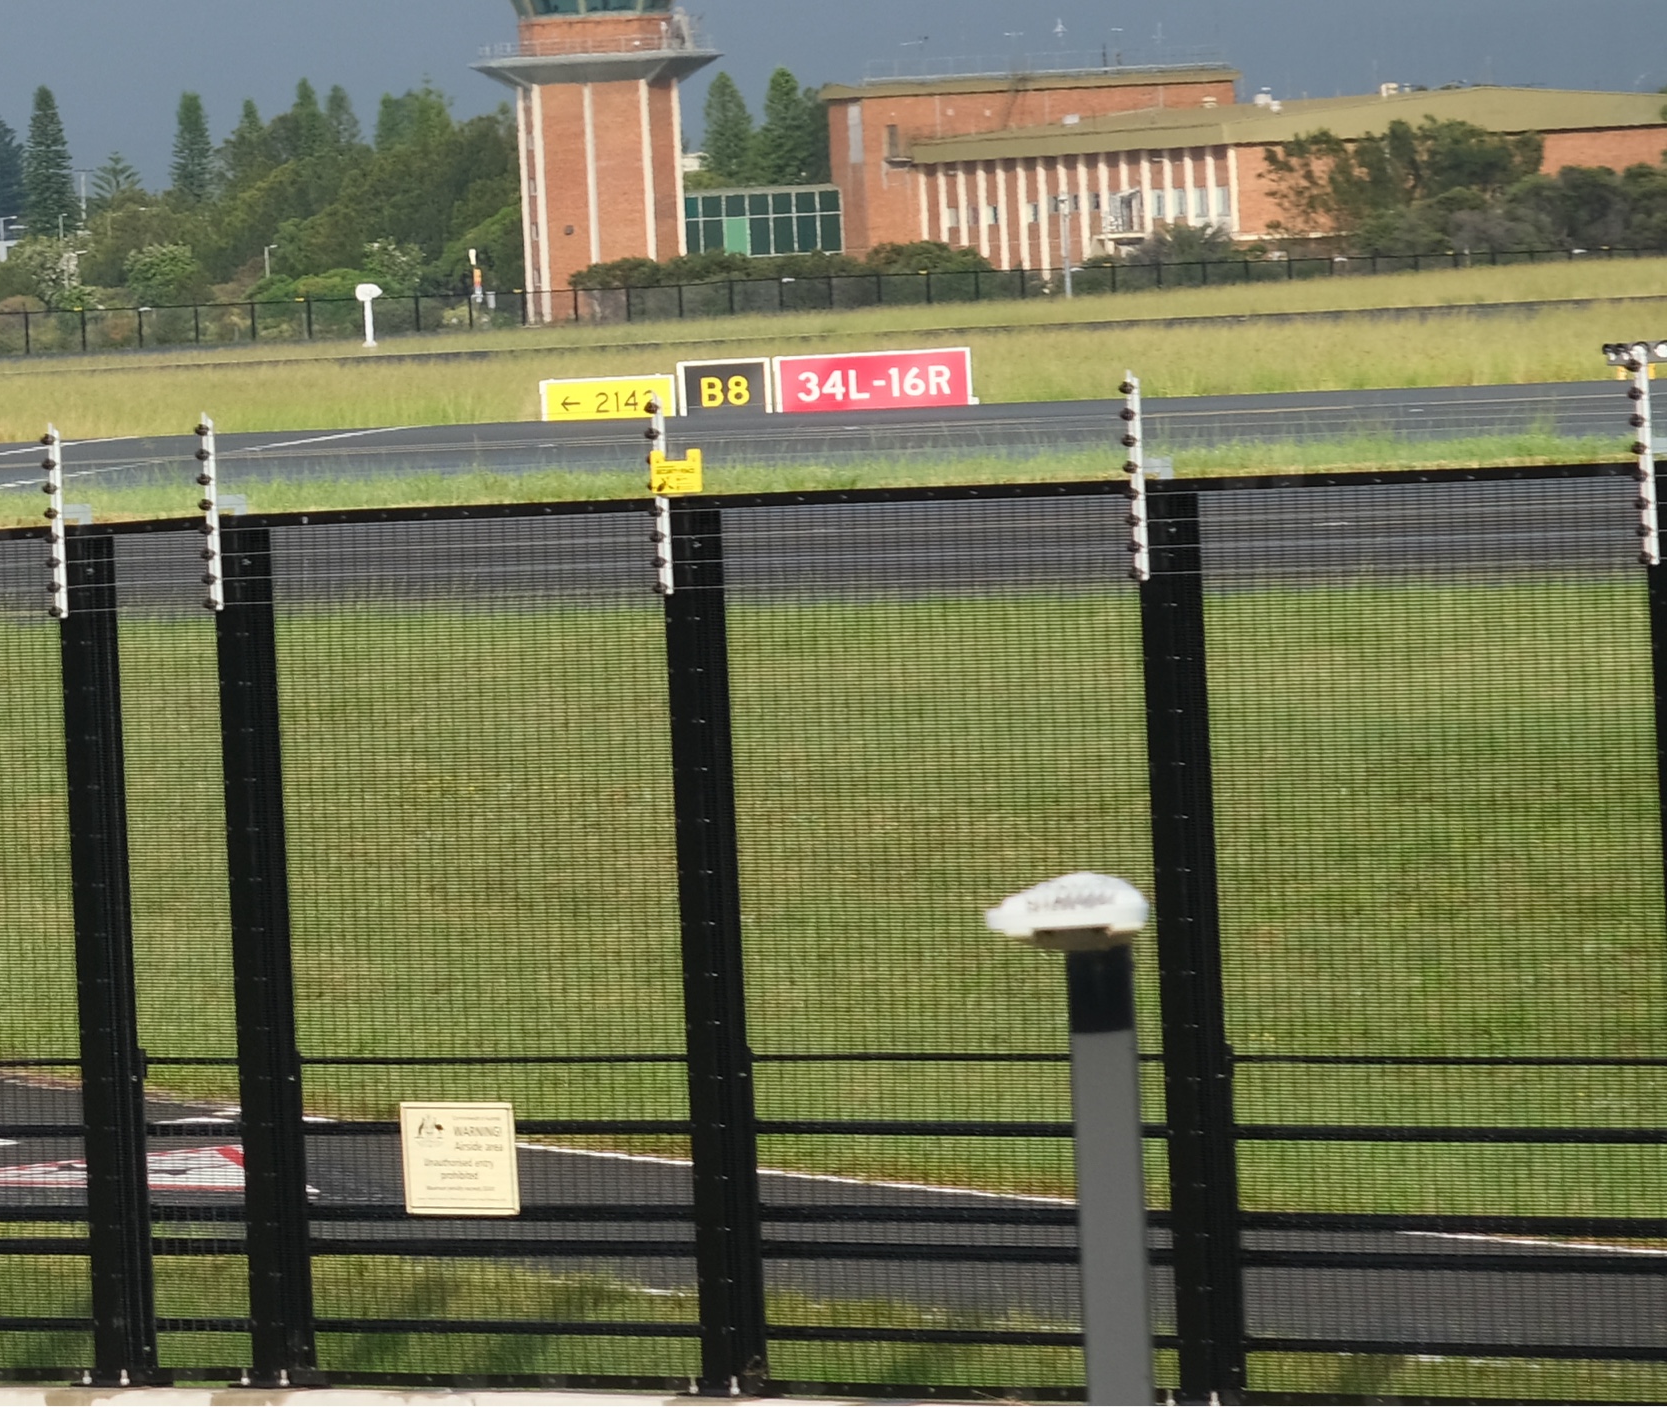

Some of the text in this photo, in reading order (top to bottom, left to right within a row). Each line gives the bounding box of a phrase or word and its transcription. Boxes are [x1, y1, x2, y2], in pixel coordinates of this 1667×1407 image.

[797, 365, 952, 403] 34L-16R
[699, 375, 751, 407] B8
[455, 1141, 504, 1152] Airside area
[475, 1159, 494, 1170] entry
[440, 1171, 479, 1180] prohibited
